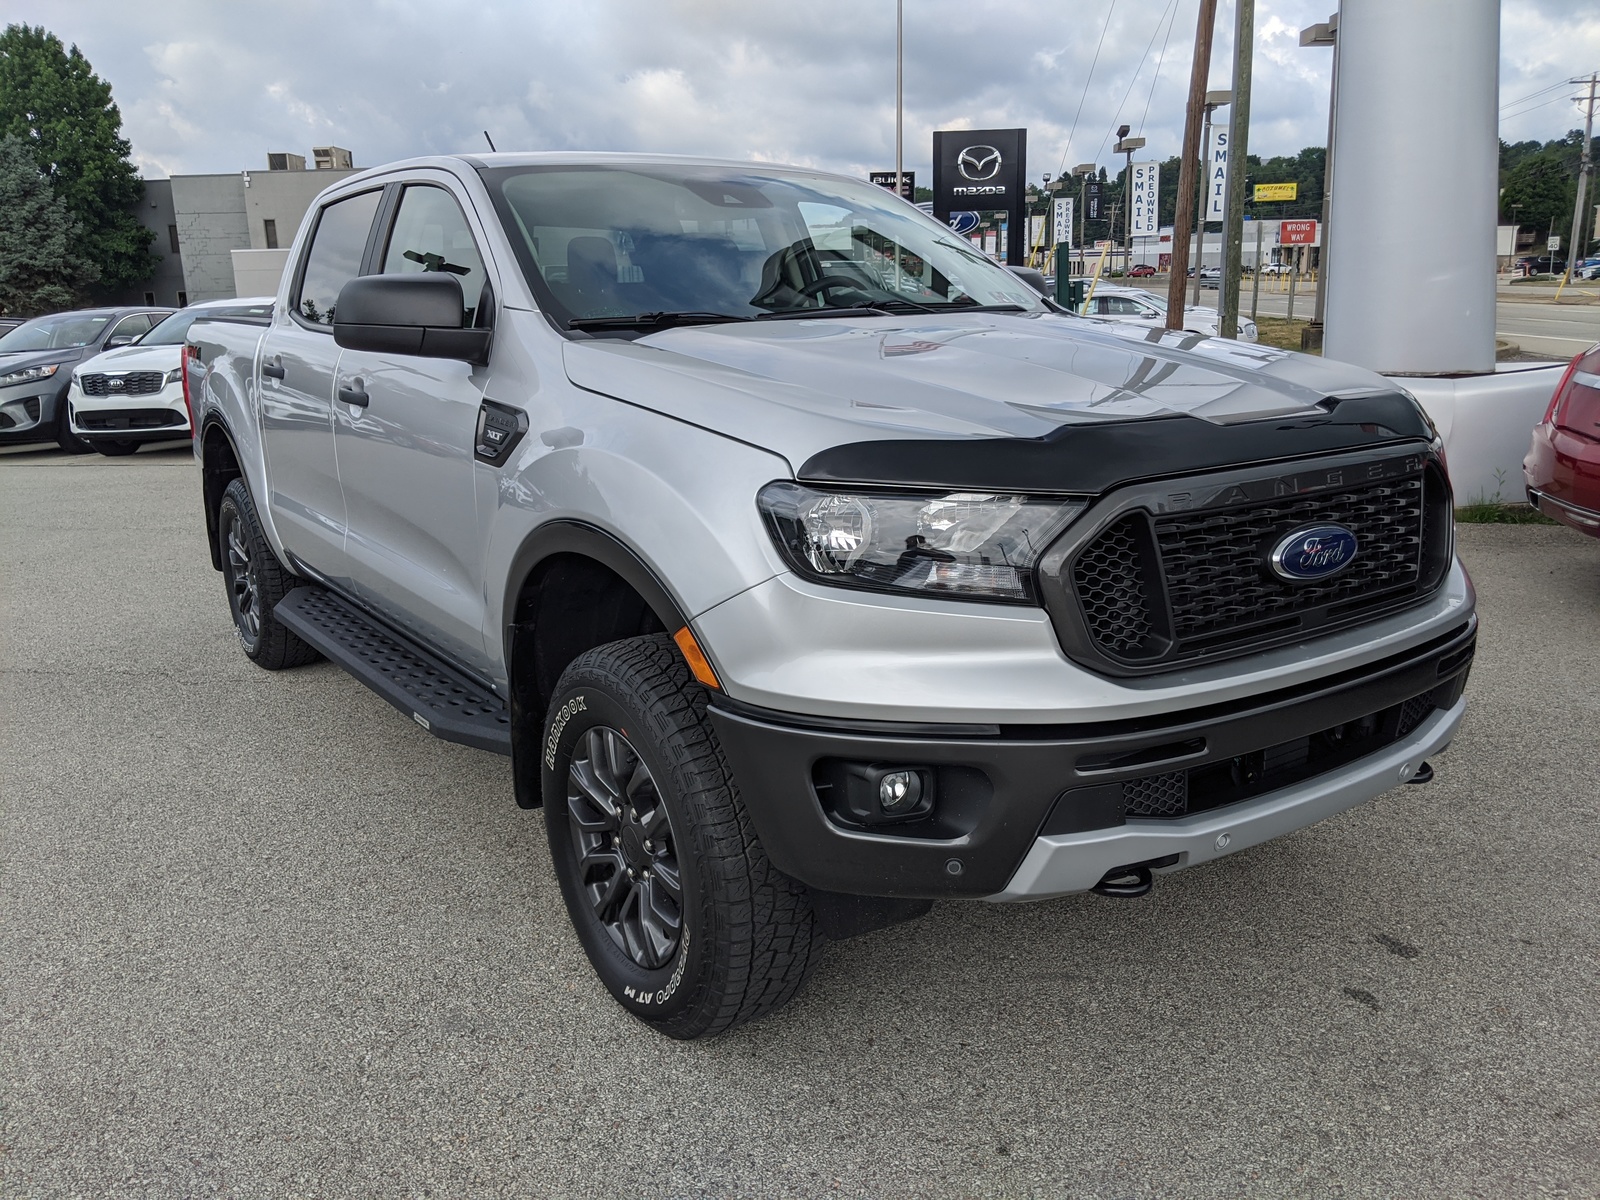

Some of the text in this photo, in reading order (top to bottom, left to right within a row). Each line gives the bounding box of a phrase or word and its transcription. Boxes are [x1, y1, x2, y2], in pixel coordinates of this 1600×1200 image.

[1213, 133, 1227, 212] SMAIL
[1135, 168, 1144, 229] SMAIL
[1146, 166, 1155, 231] PREOWNED
[1287, 223, 1310, 231] WRONG
[1291, 233, 1305, 241] WAY
[487, 429, 503, 441] XLT
[1167, 457, 1423, 510] RANGER
[1300, 535, 1345, 570] Ford
